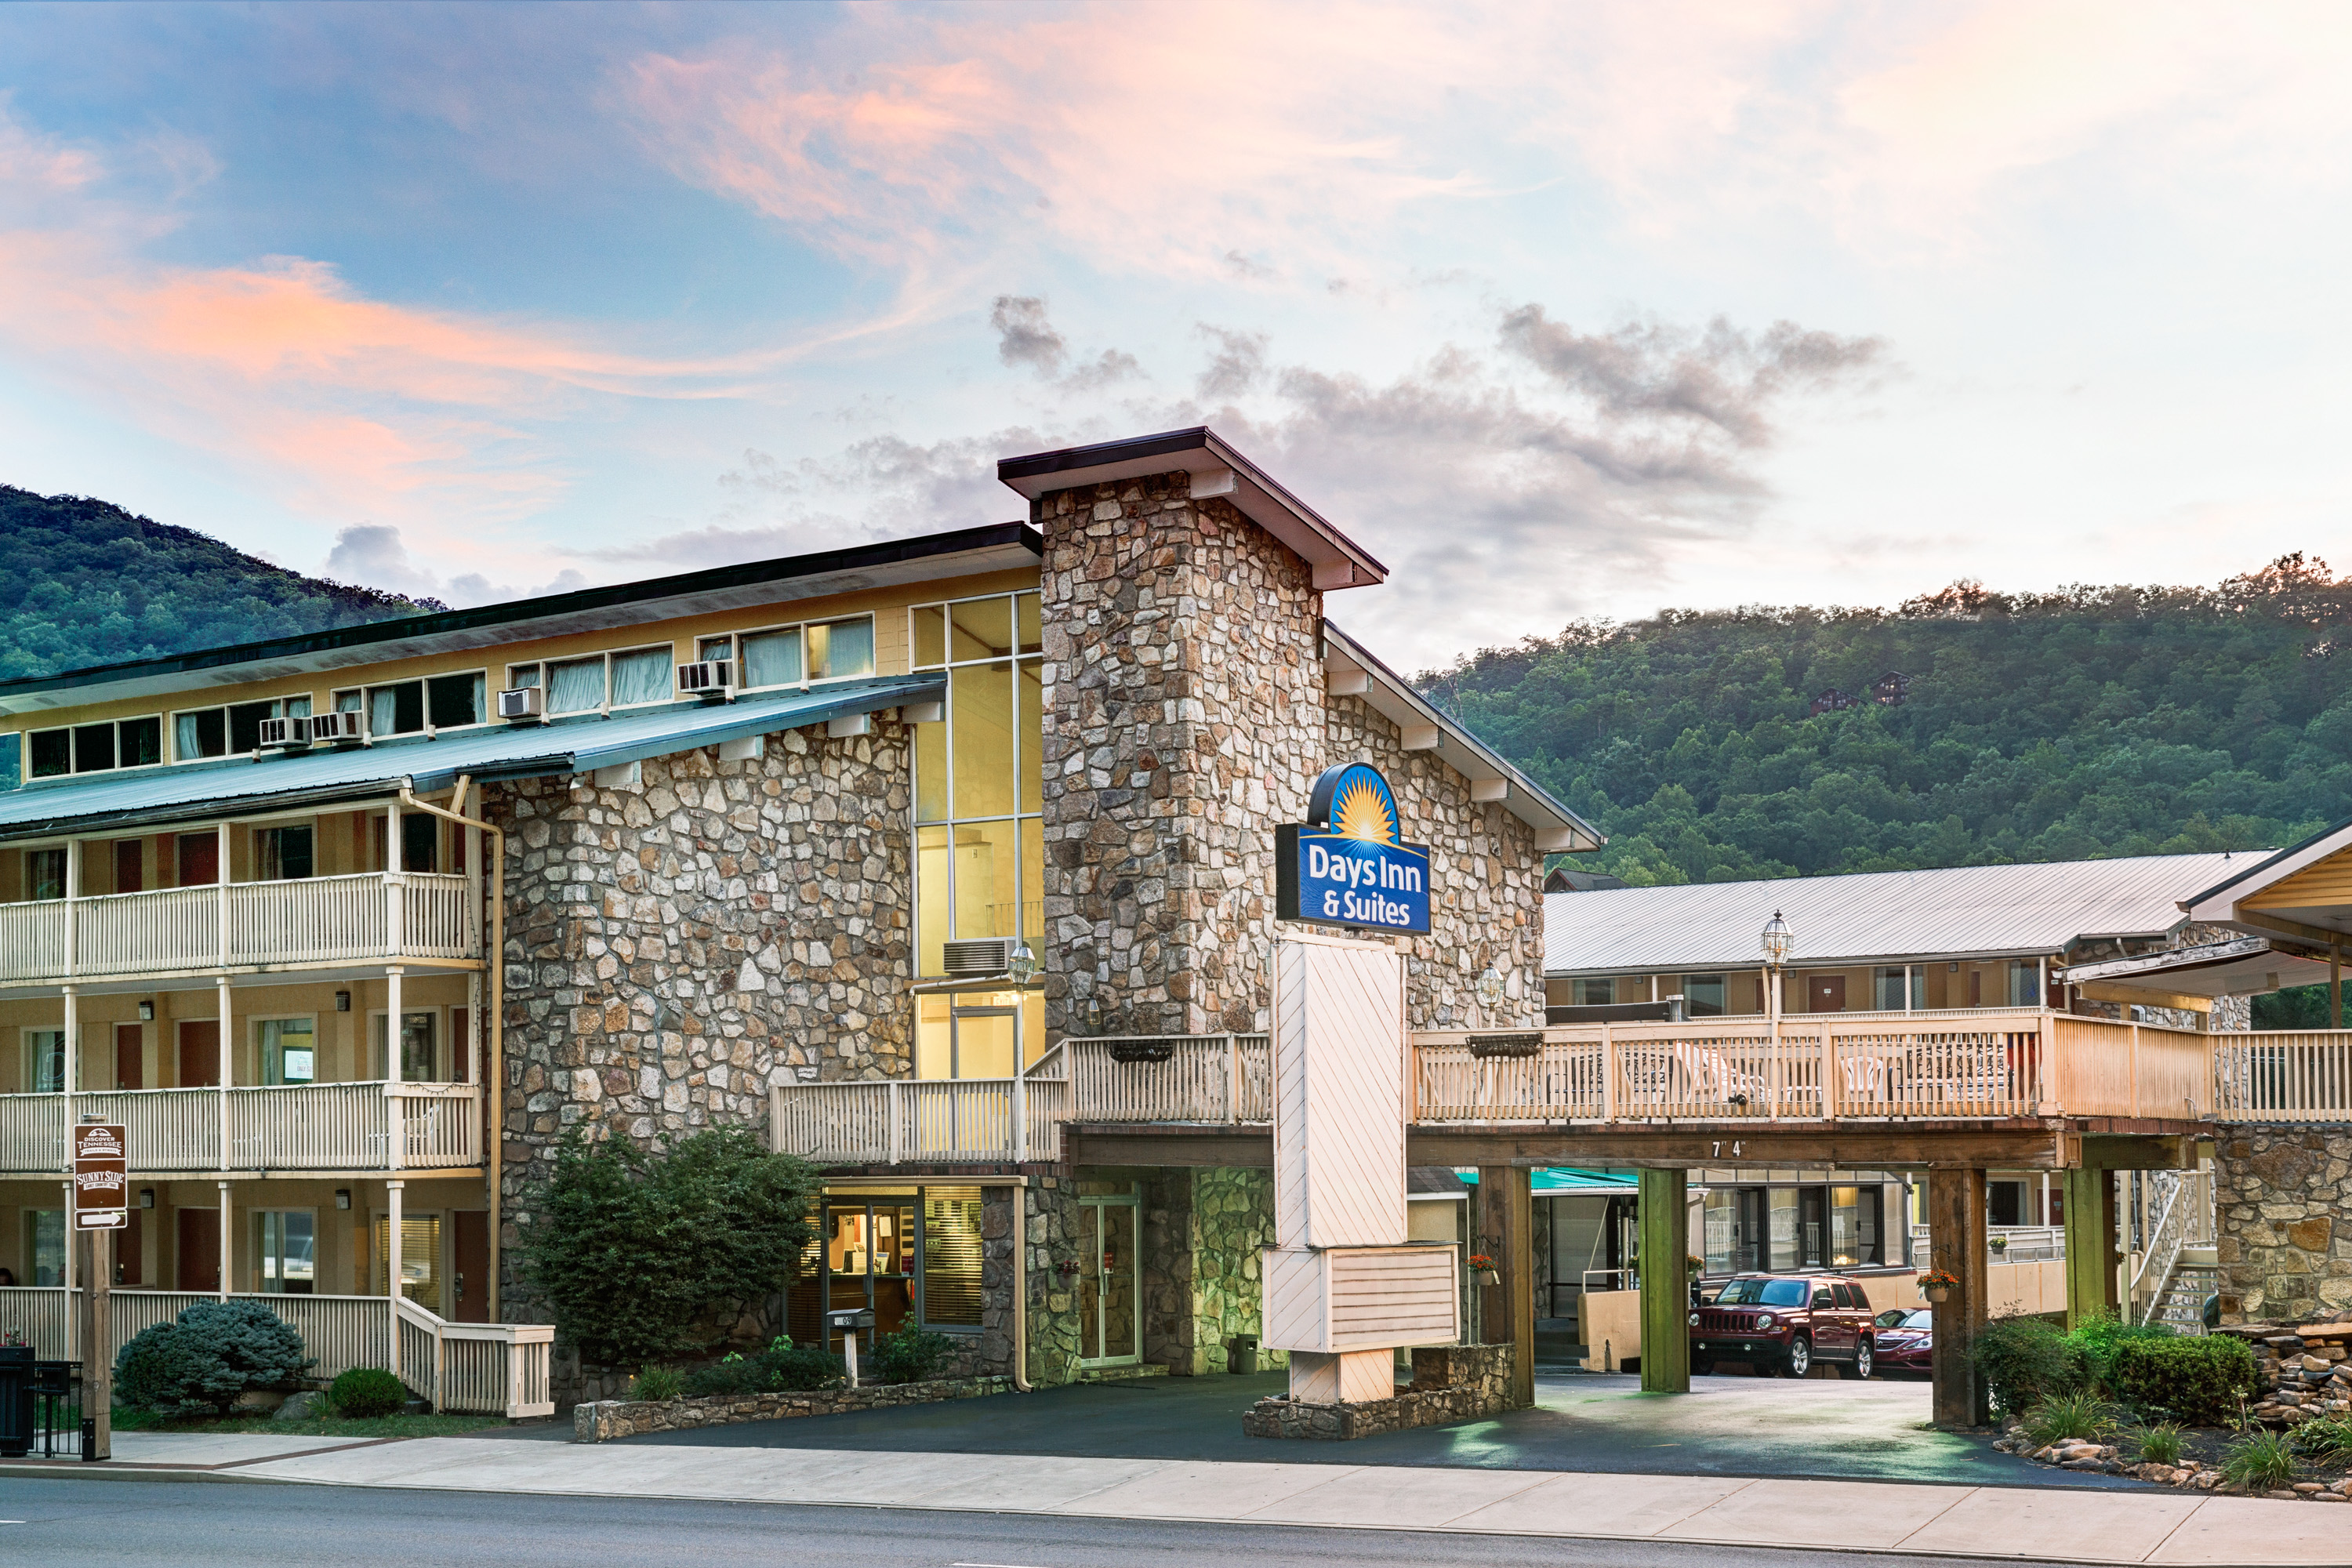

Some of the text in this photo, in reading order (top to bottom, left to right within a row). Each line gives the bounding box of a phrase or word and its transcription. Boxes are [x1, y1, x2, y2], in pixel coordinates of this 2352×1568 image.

[1309, 844, 1421, 893] Days Inn
[1323, 890, 1410, 925] & Suites
[1712, 1142, 1720, 1156] 7
[1733, 1141, 1740, 1156] 4
[76, 1171, 125, 1185] SUNNY SIDE
